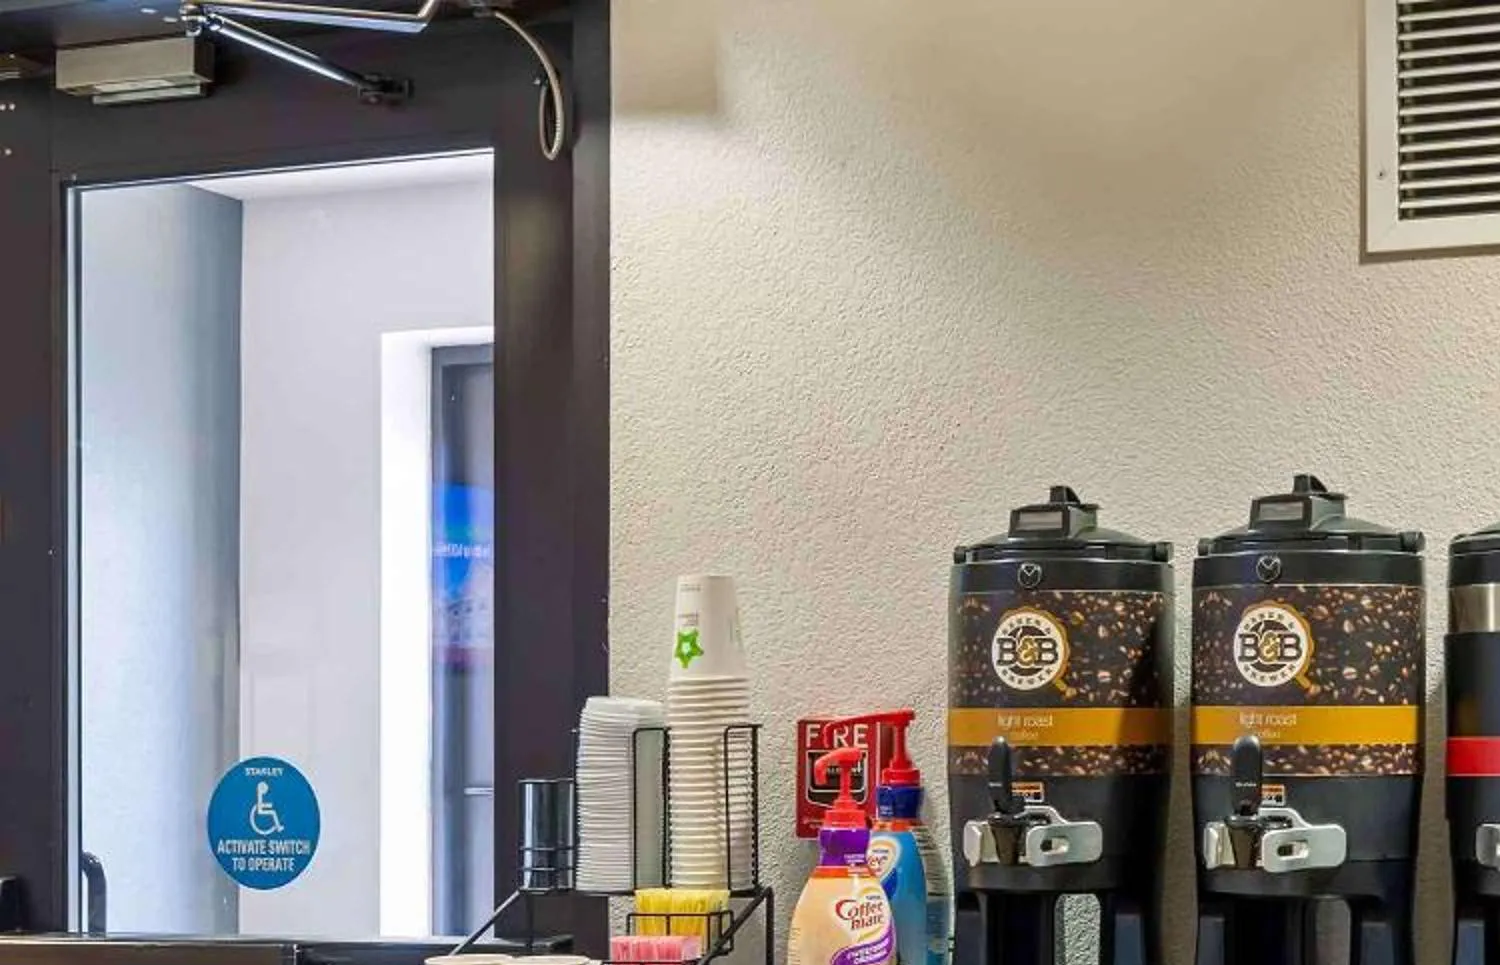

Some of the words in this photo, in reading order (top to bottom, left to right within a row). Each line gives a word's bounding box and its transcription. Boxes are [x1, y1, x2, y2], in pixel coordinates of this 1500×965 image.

[806, 723, 869, 748] FRE
[217, 840, 267, 855] ACTIVATE
[269, 840, 311, 855] SWITCH
[232, 858, 246, 871] TO
[247, 858, 295, 872] OPERATE
